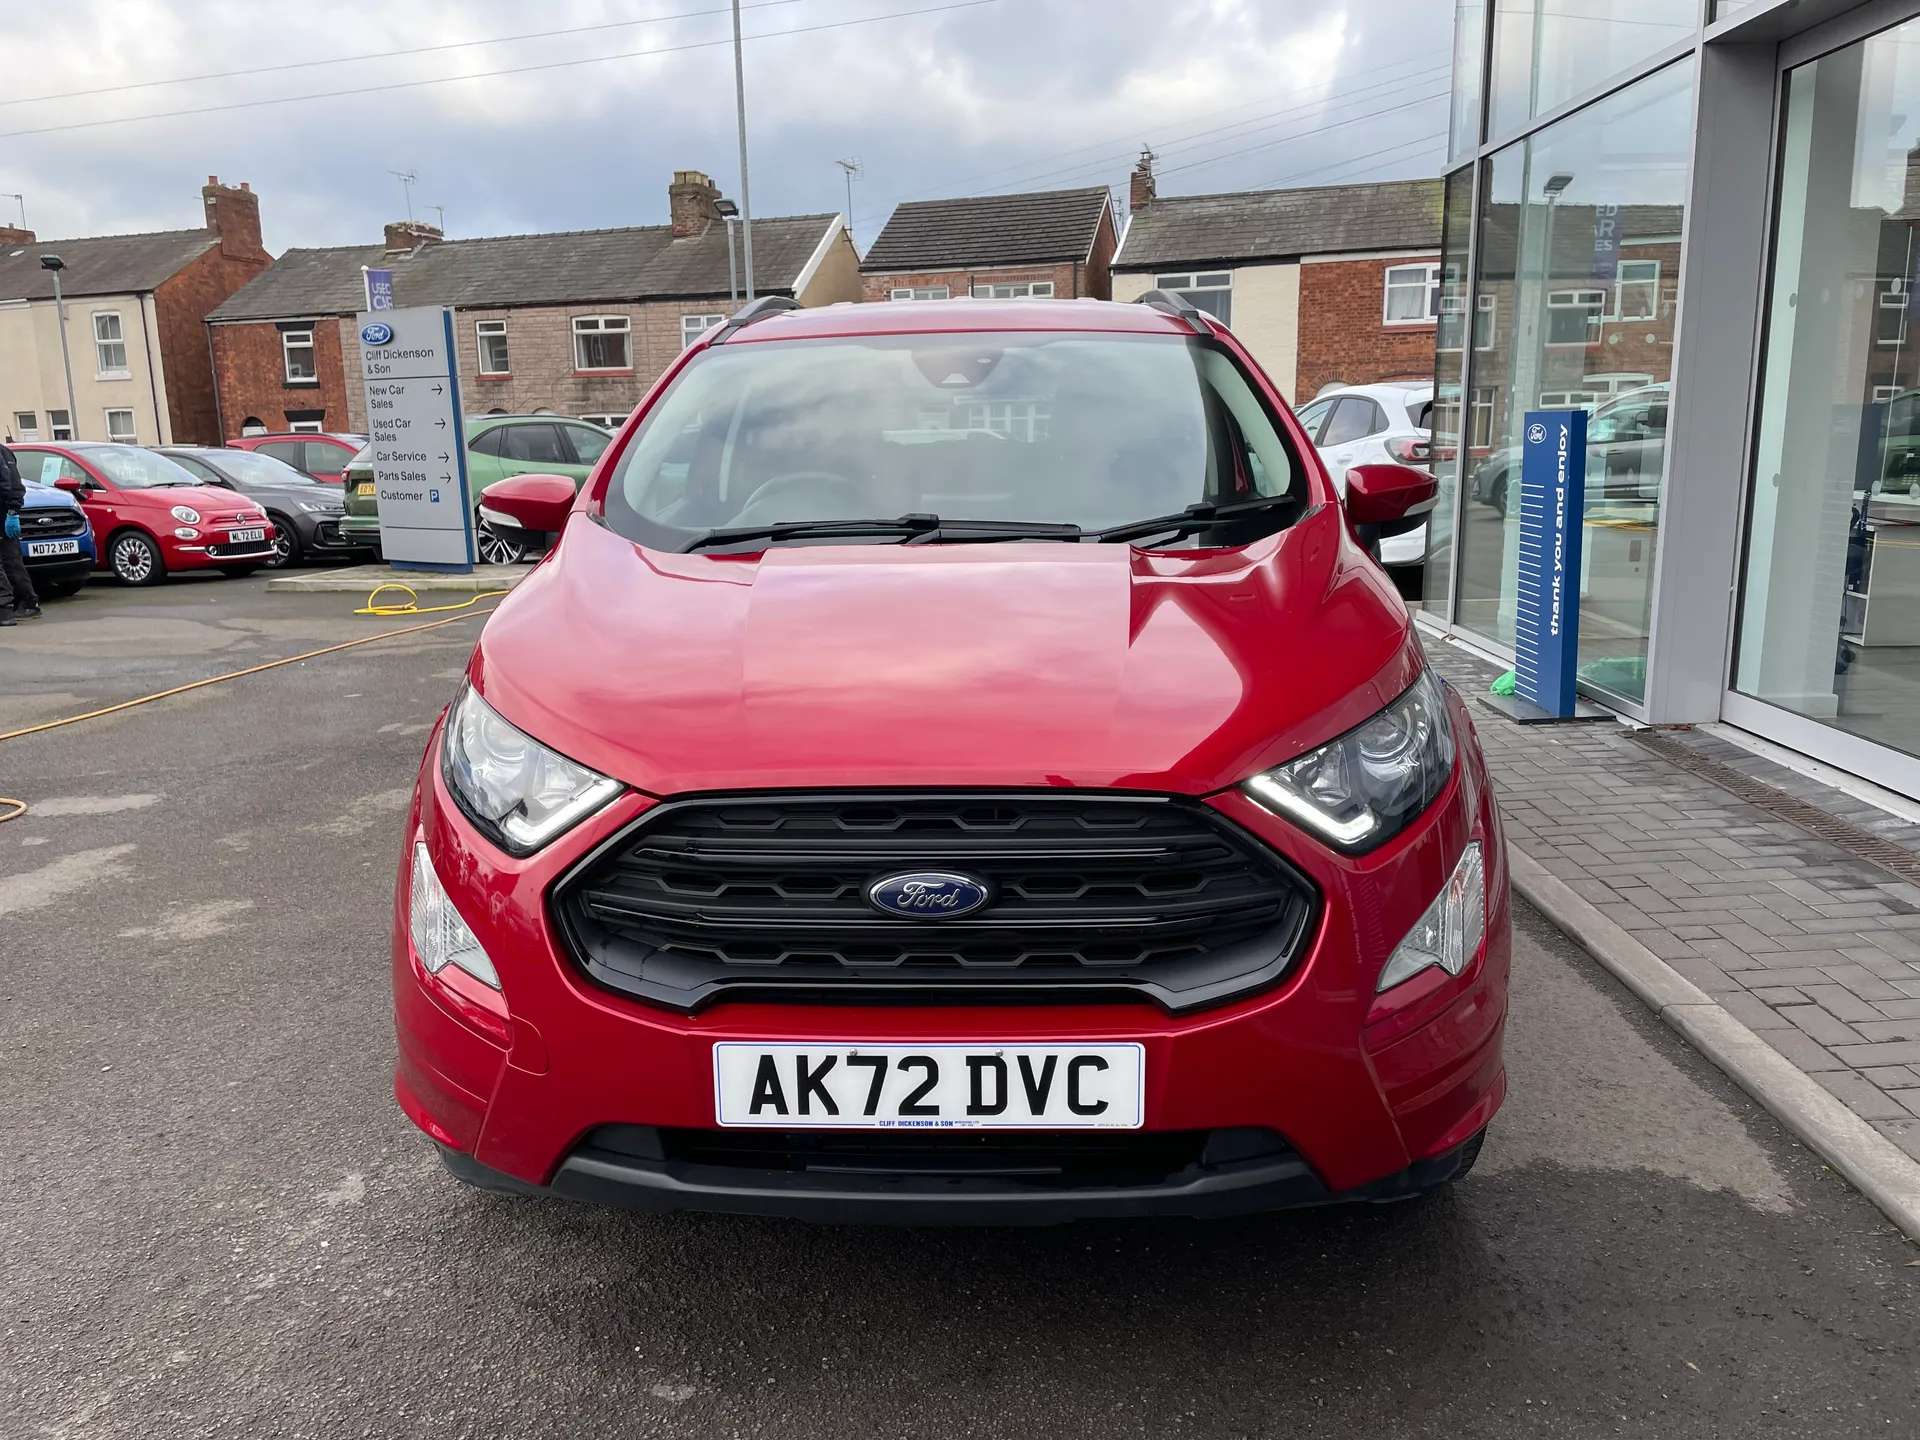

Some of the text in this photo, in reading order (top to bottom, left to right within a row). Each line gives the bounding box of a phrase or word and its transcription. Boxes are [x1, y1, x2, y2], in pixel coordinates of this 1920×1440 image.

[366, 326, 384, 340] Ford
[366, 348, 434, 360] Cliff Dickenson
[368, 364, 390, 374] & Son
[369, 385, 404, 396] New Car
[371, 399, 394, 409] Sales
[373, 418, 411, 428] Used Car
[374, 432, 397, 442] Sales
[376, 451, 427, 461] Car Service
[1558, 424, 1568, 483] enjoy
[379, 471, 426, 481] Parts Sales
[381, 490, 422, 501] Customer
[32, 542, 75, 554] MD72 XRP
[1553, 532, 1563, 572] you
[1550, 575, 1561, 636] thank
[896, 882, 960, 908] Ford
[748, 1054, 1110, 1116] AK72 DVC
